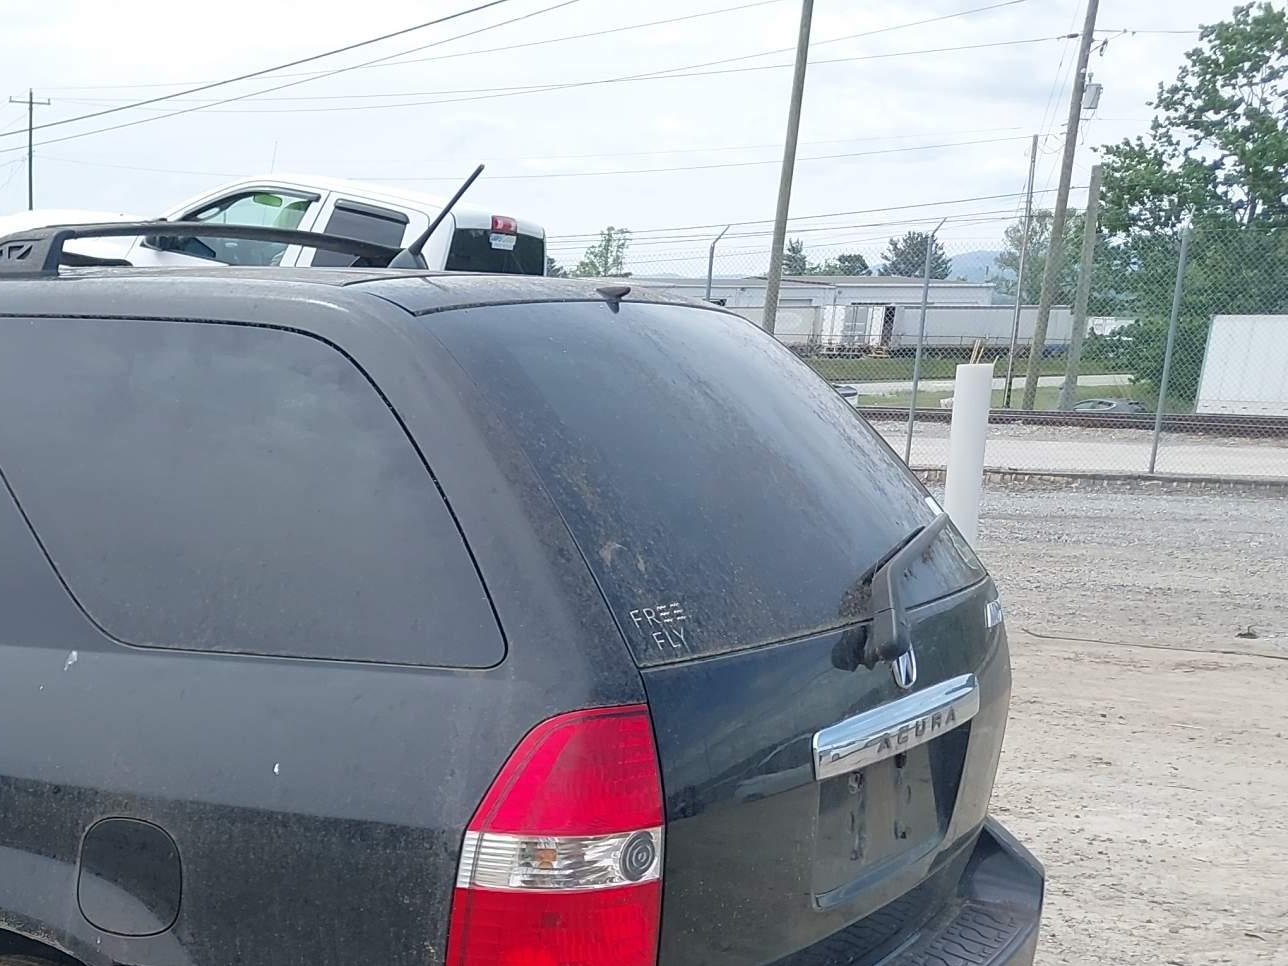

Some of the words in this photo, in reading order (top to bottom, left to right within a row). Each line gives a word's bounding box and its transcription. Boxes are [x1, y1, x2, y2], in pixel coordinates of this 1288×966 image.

[629, 602, 687, 629] FREE
[652, 626, 691, 653] FLY
[877, 705, 957, 753] ACURA
